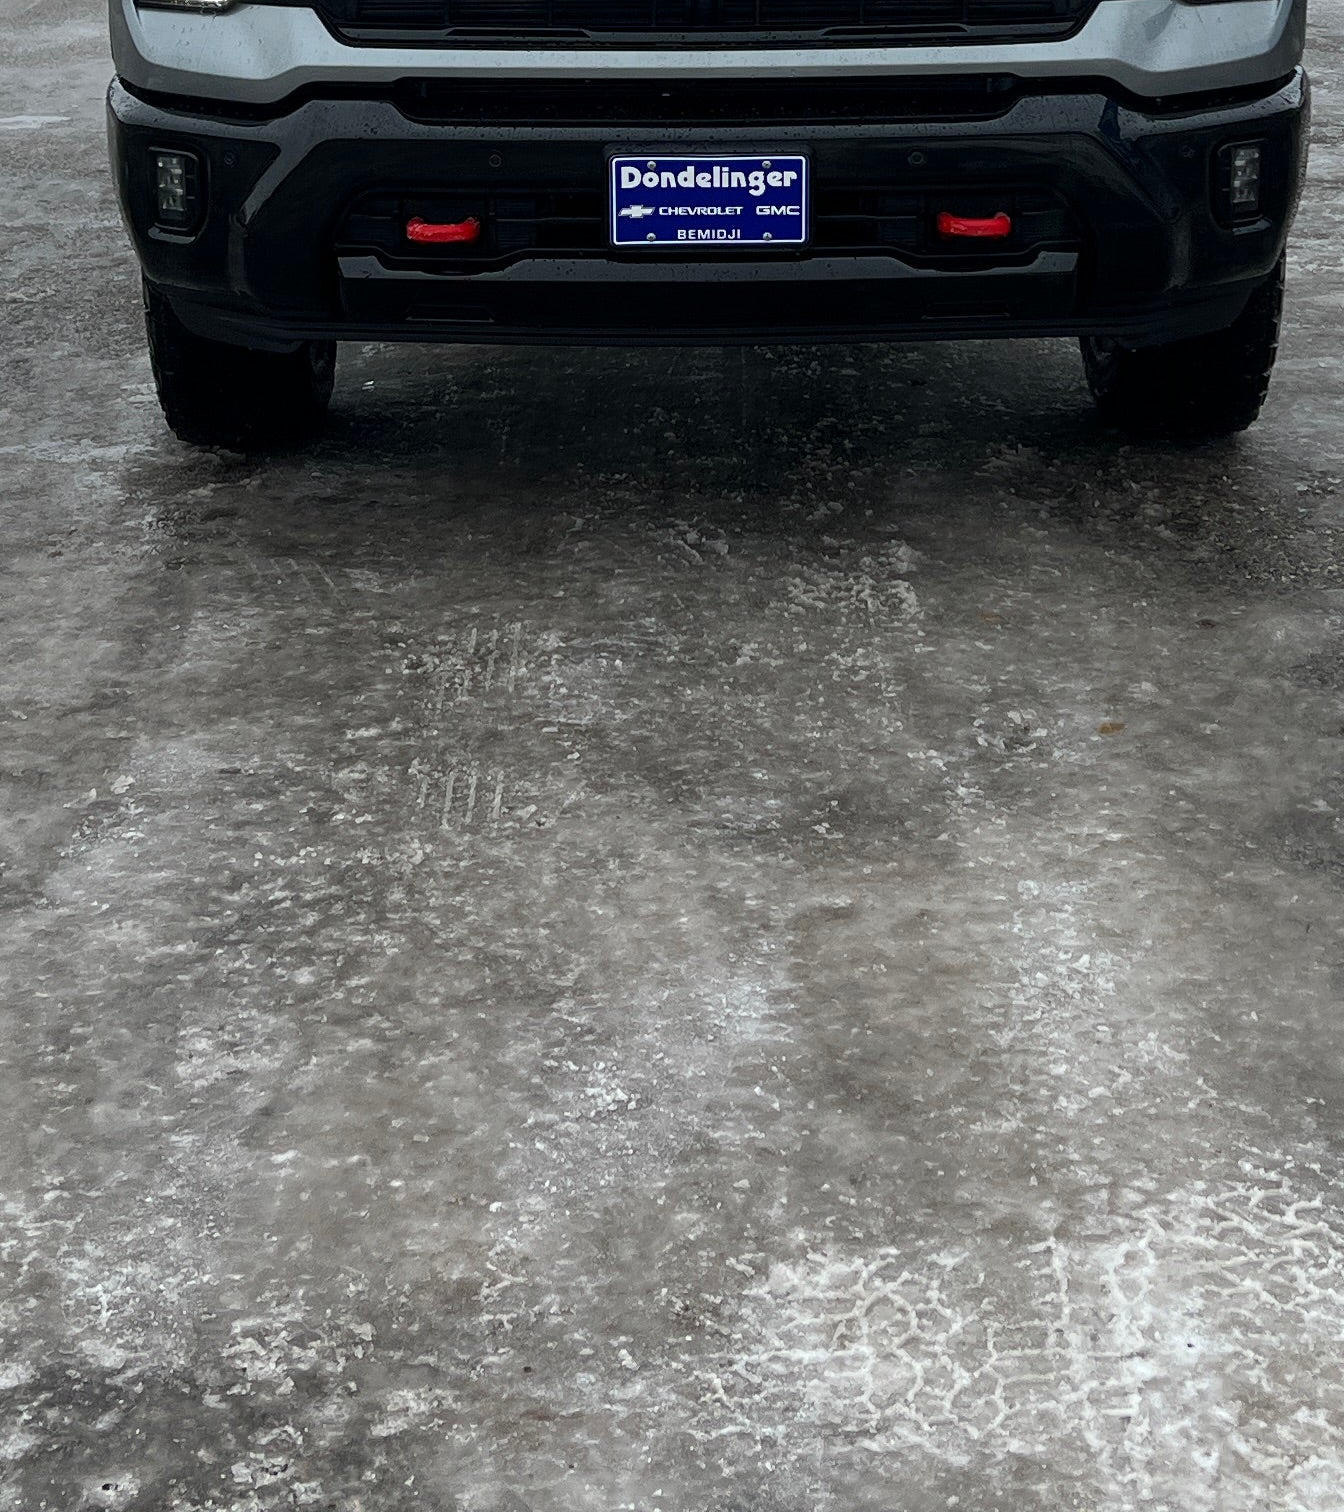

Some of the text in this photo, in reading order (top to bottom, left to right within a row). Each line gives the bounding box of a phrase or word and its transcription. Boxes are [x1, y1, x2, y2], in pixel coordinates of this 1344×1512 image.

[621, 166, 798, 197] Dondelinger
[658, 205, 801, 216] CHEVROLET GMC
[677, 228, 741, 240] BEMIDJI
